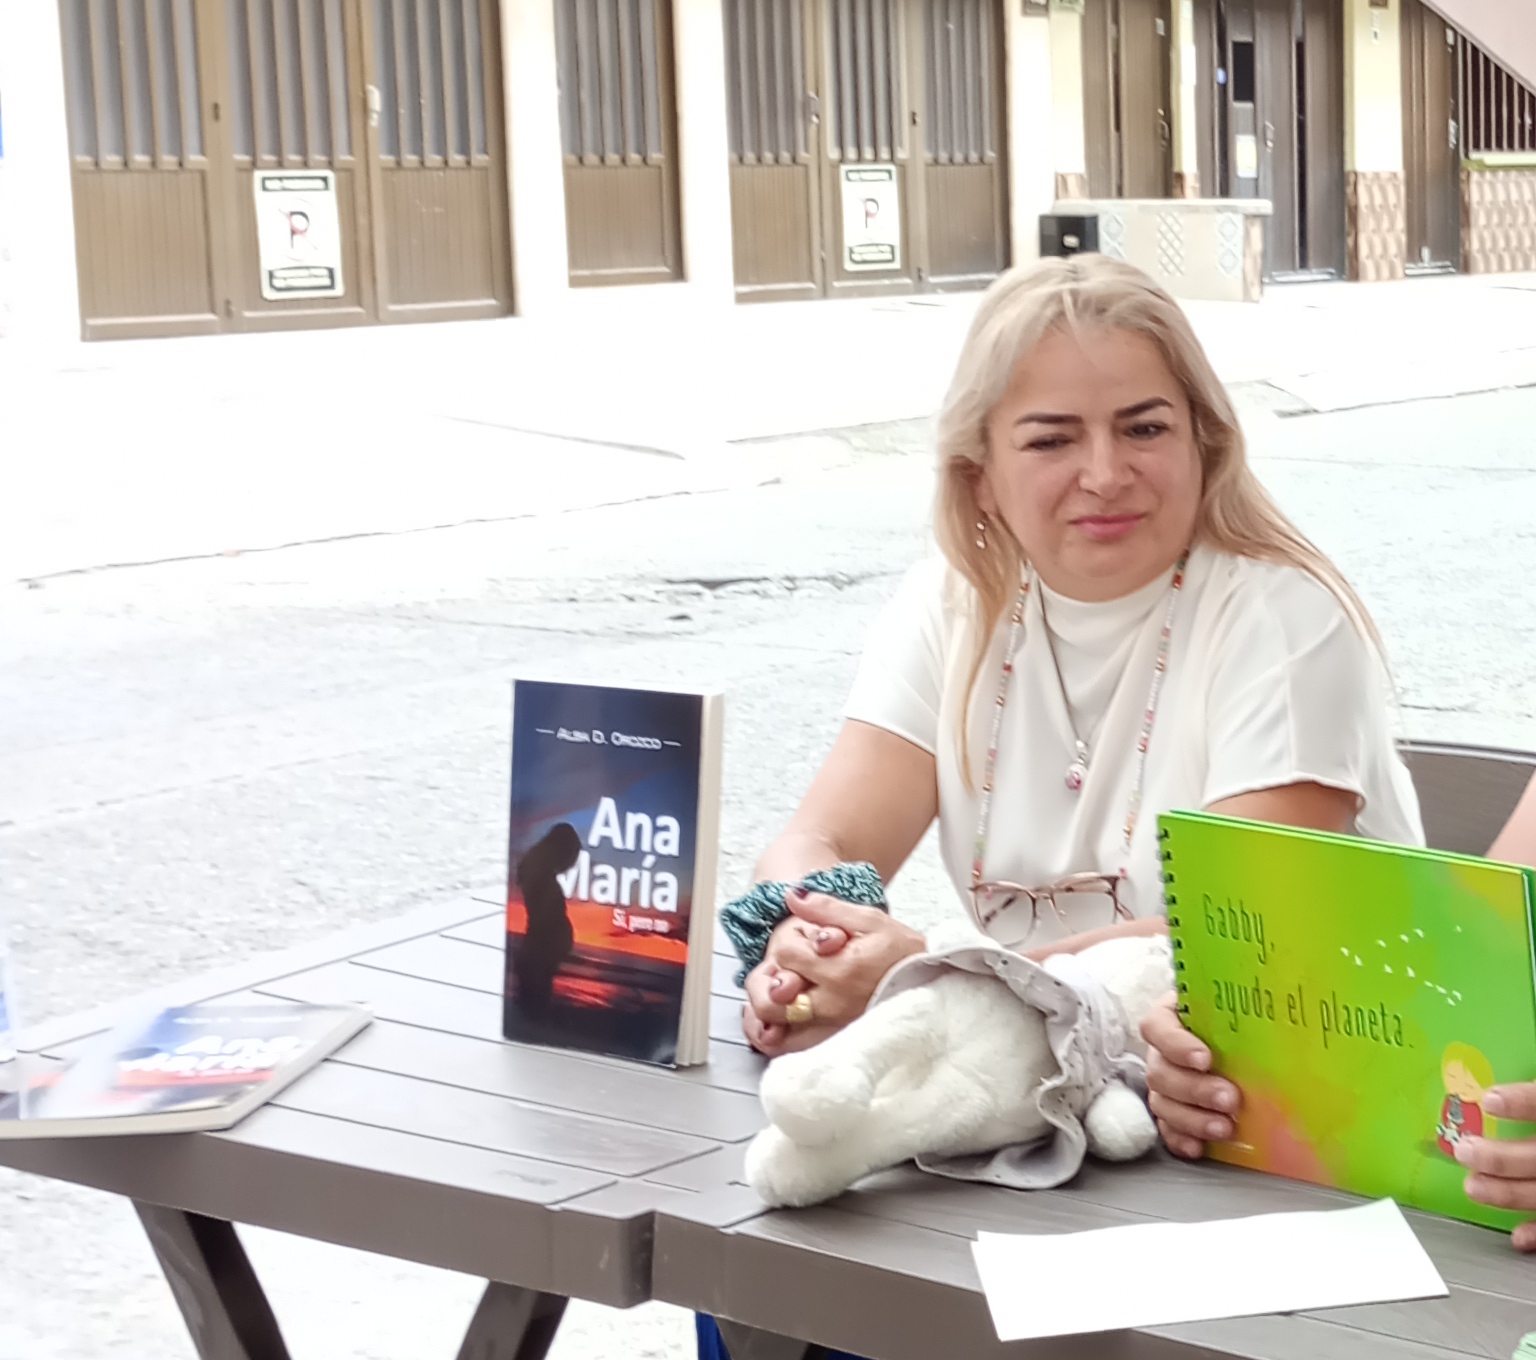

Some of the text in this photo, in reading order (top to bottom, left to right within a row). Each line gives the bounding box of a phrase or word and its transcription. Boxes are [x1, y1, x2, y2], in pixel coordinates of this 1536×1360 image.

[587, 796, 681, 857] Ana
[1213, 976, 1276, 1033] ayuda
[1287, 983, 1308, 1028] el
